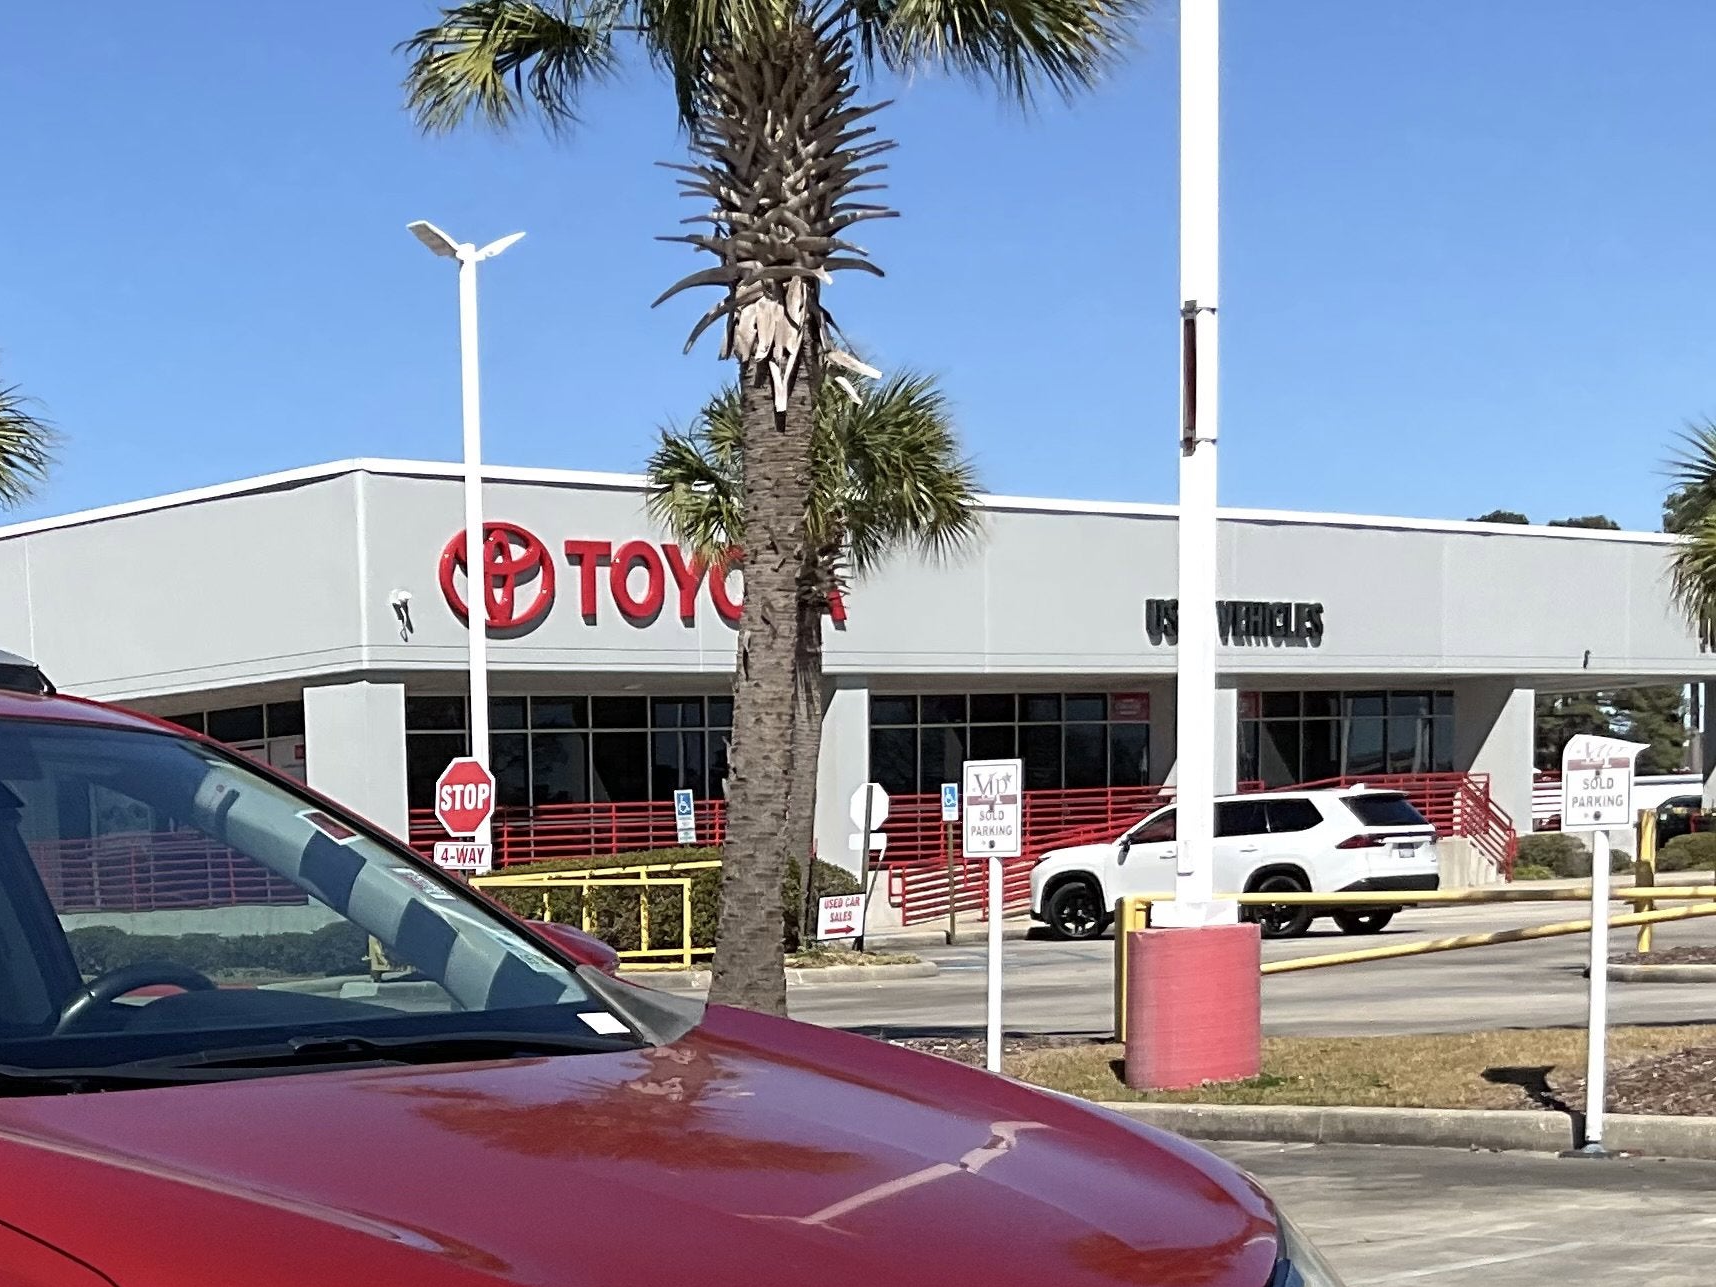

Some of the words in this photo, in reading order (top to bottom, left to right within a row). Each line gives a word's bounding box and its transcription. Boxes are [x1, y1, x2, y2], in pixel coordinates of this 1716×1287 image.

[564, 540, 847, 630] TOYO
[1215, 600, 1324, 648] VEHICLES
[1583, 777, 1614, 790] SOLD
[440, 783, 490, 812] STOP
[1571, 794, 1624, 808] PARKING
[979, 810, 1005, 821] SOLD
[970, 824, 1013, 837] PARKING
[440, 847, 485, 864] 4-WAY
[824, 898, 843, 910] USED
[845, 896, 860, 908] CAR
[830, 910, 853, 923] SALES
